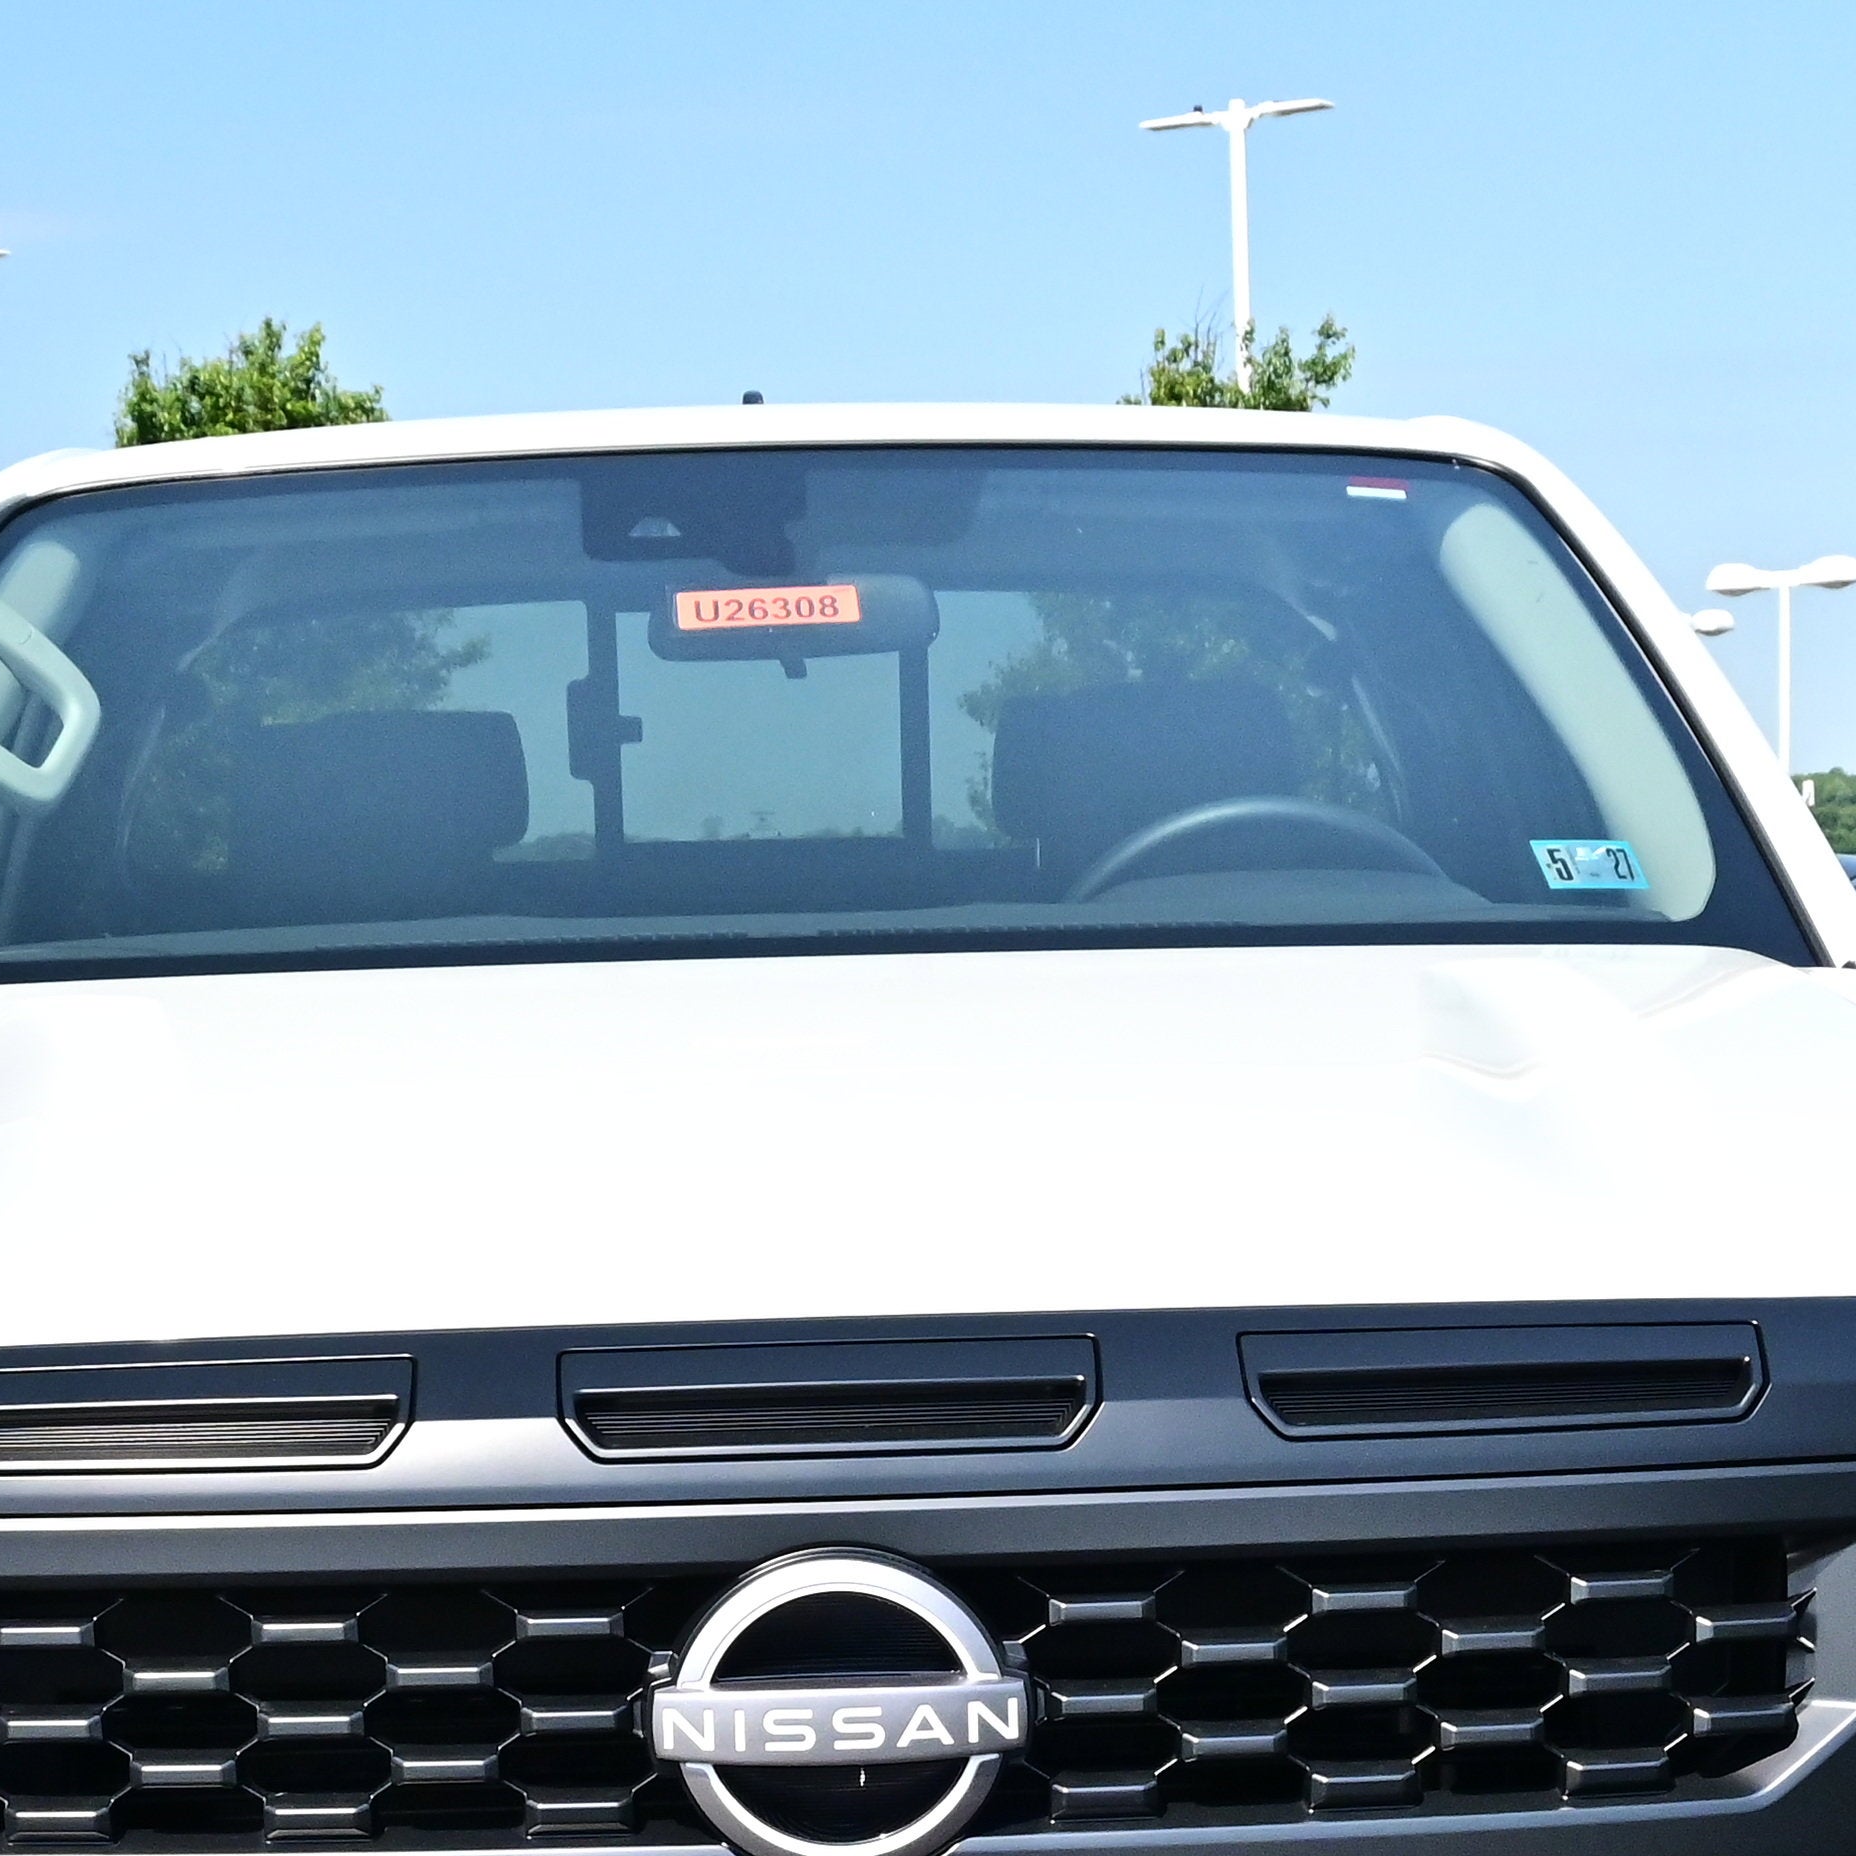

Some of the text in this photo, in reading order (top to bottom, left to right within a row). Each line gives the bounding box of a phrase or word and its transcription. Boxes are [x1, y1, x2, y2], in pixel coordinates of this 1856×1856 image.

[694, 595, 840, 622] U26308
[1546, 848, 1635, 882] 5 27
[661, 1697, 1020, 1752] NISSAN
